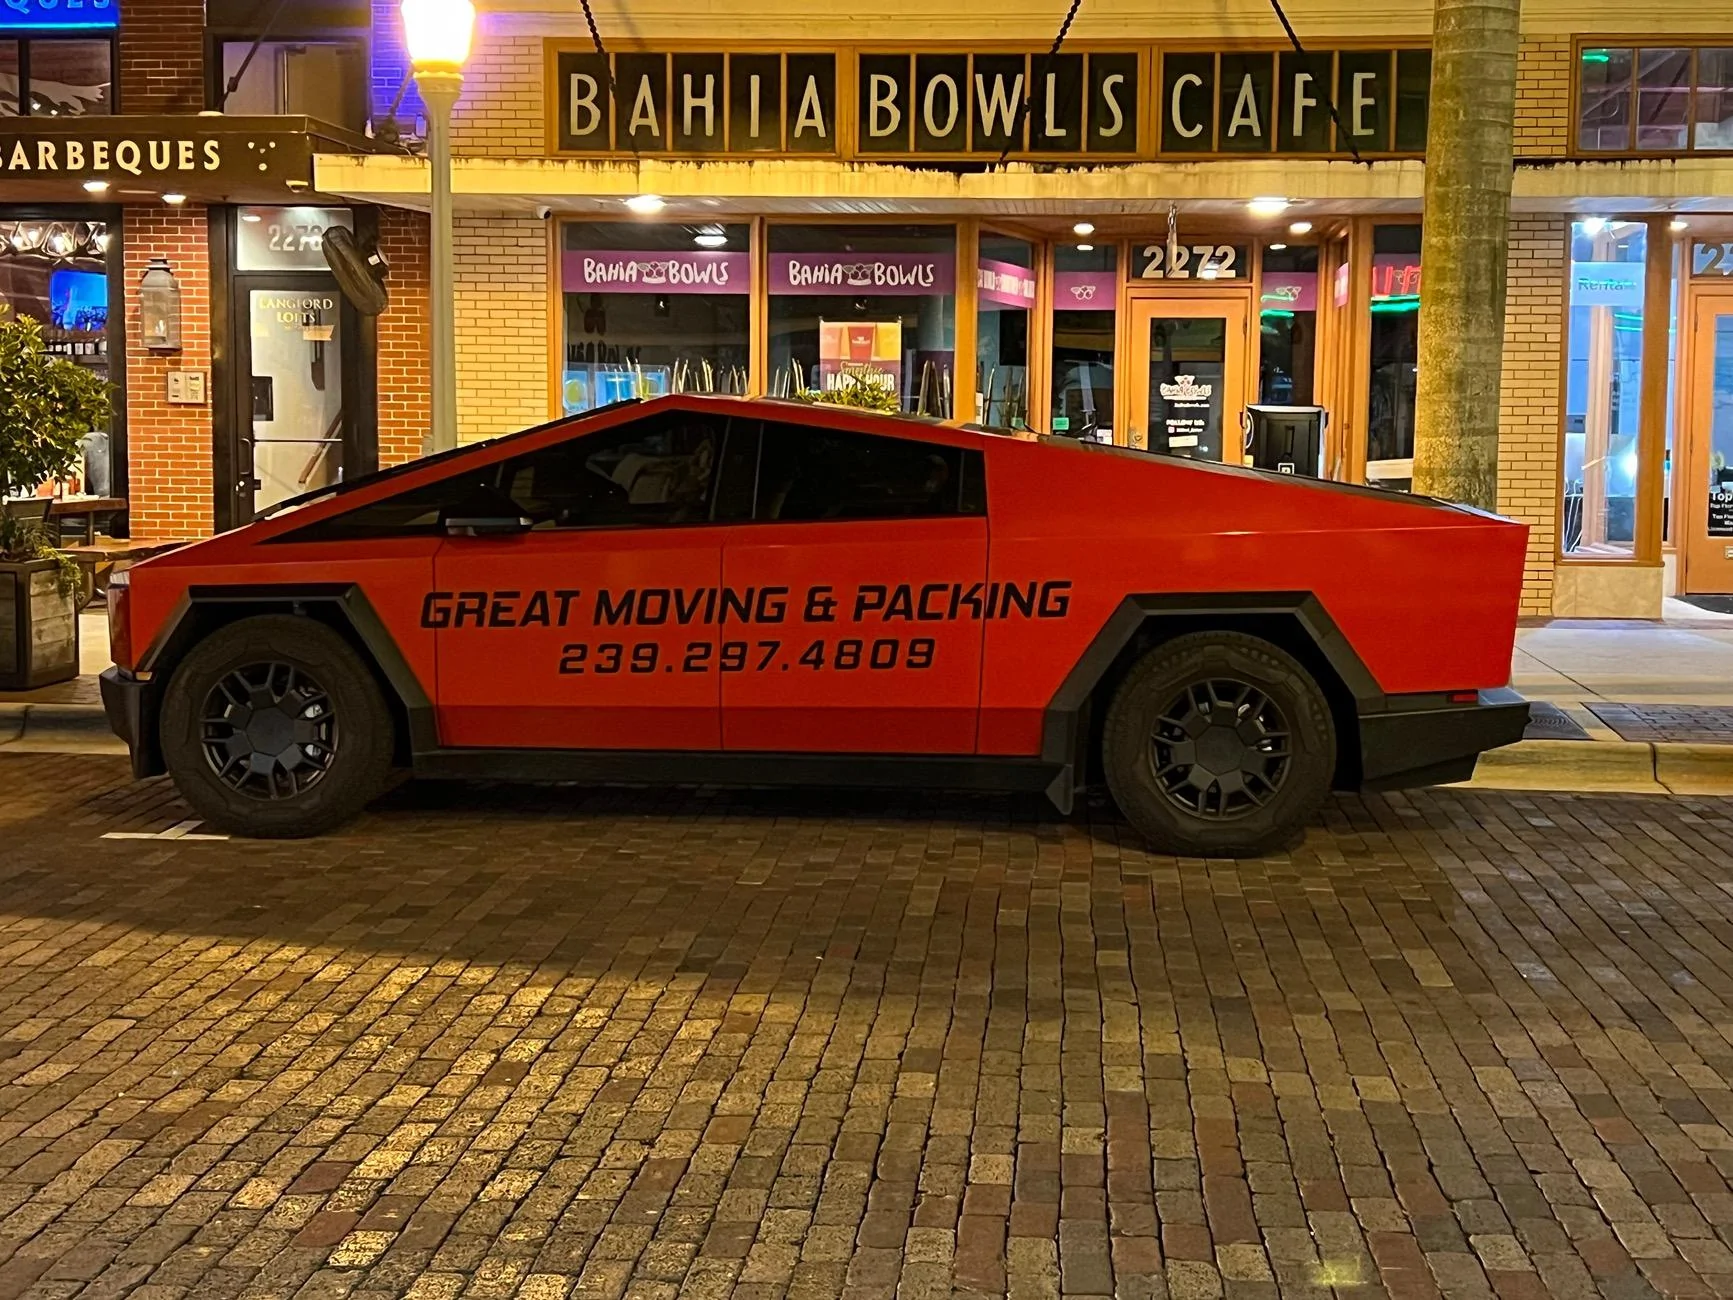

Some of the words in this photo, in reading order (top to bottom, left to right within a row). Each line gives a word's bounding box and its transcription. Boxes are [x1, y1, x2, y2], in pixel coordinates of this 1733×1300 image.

[570, 73, 827, 138] BAHIA
[870, 73, 1125, 138] BOWLS
[1171, 72, 1377, 138] CAFE
[0, 139, 221, 176] ARBEQUES
[668, 260, 729, 286] BOWLS
[874, 262, 935, 287] BOWLS
[1142, 245, 1236, 279] 2272
[1701, 243, 1733, 275] 2
[420, 590, 580, 628] GREAT
[593, 586, 788, 626] MOVING
[803, 586, 838, 622] &
[853, 581, 1072, 622] PACKING
[559, 638, 936, 675] 239.297.4809
